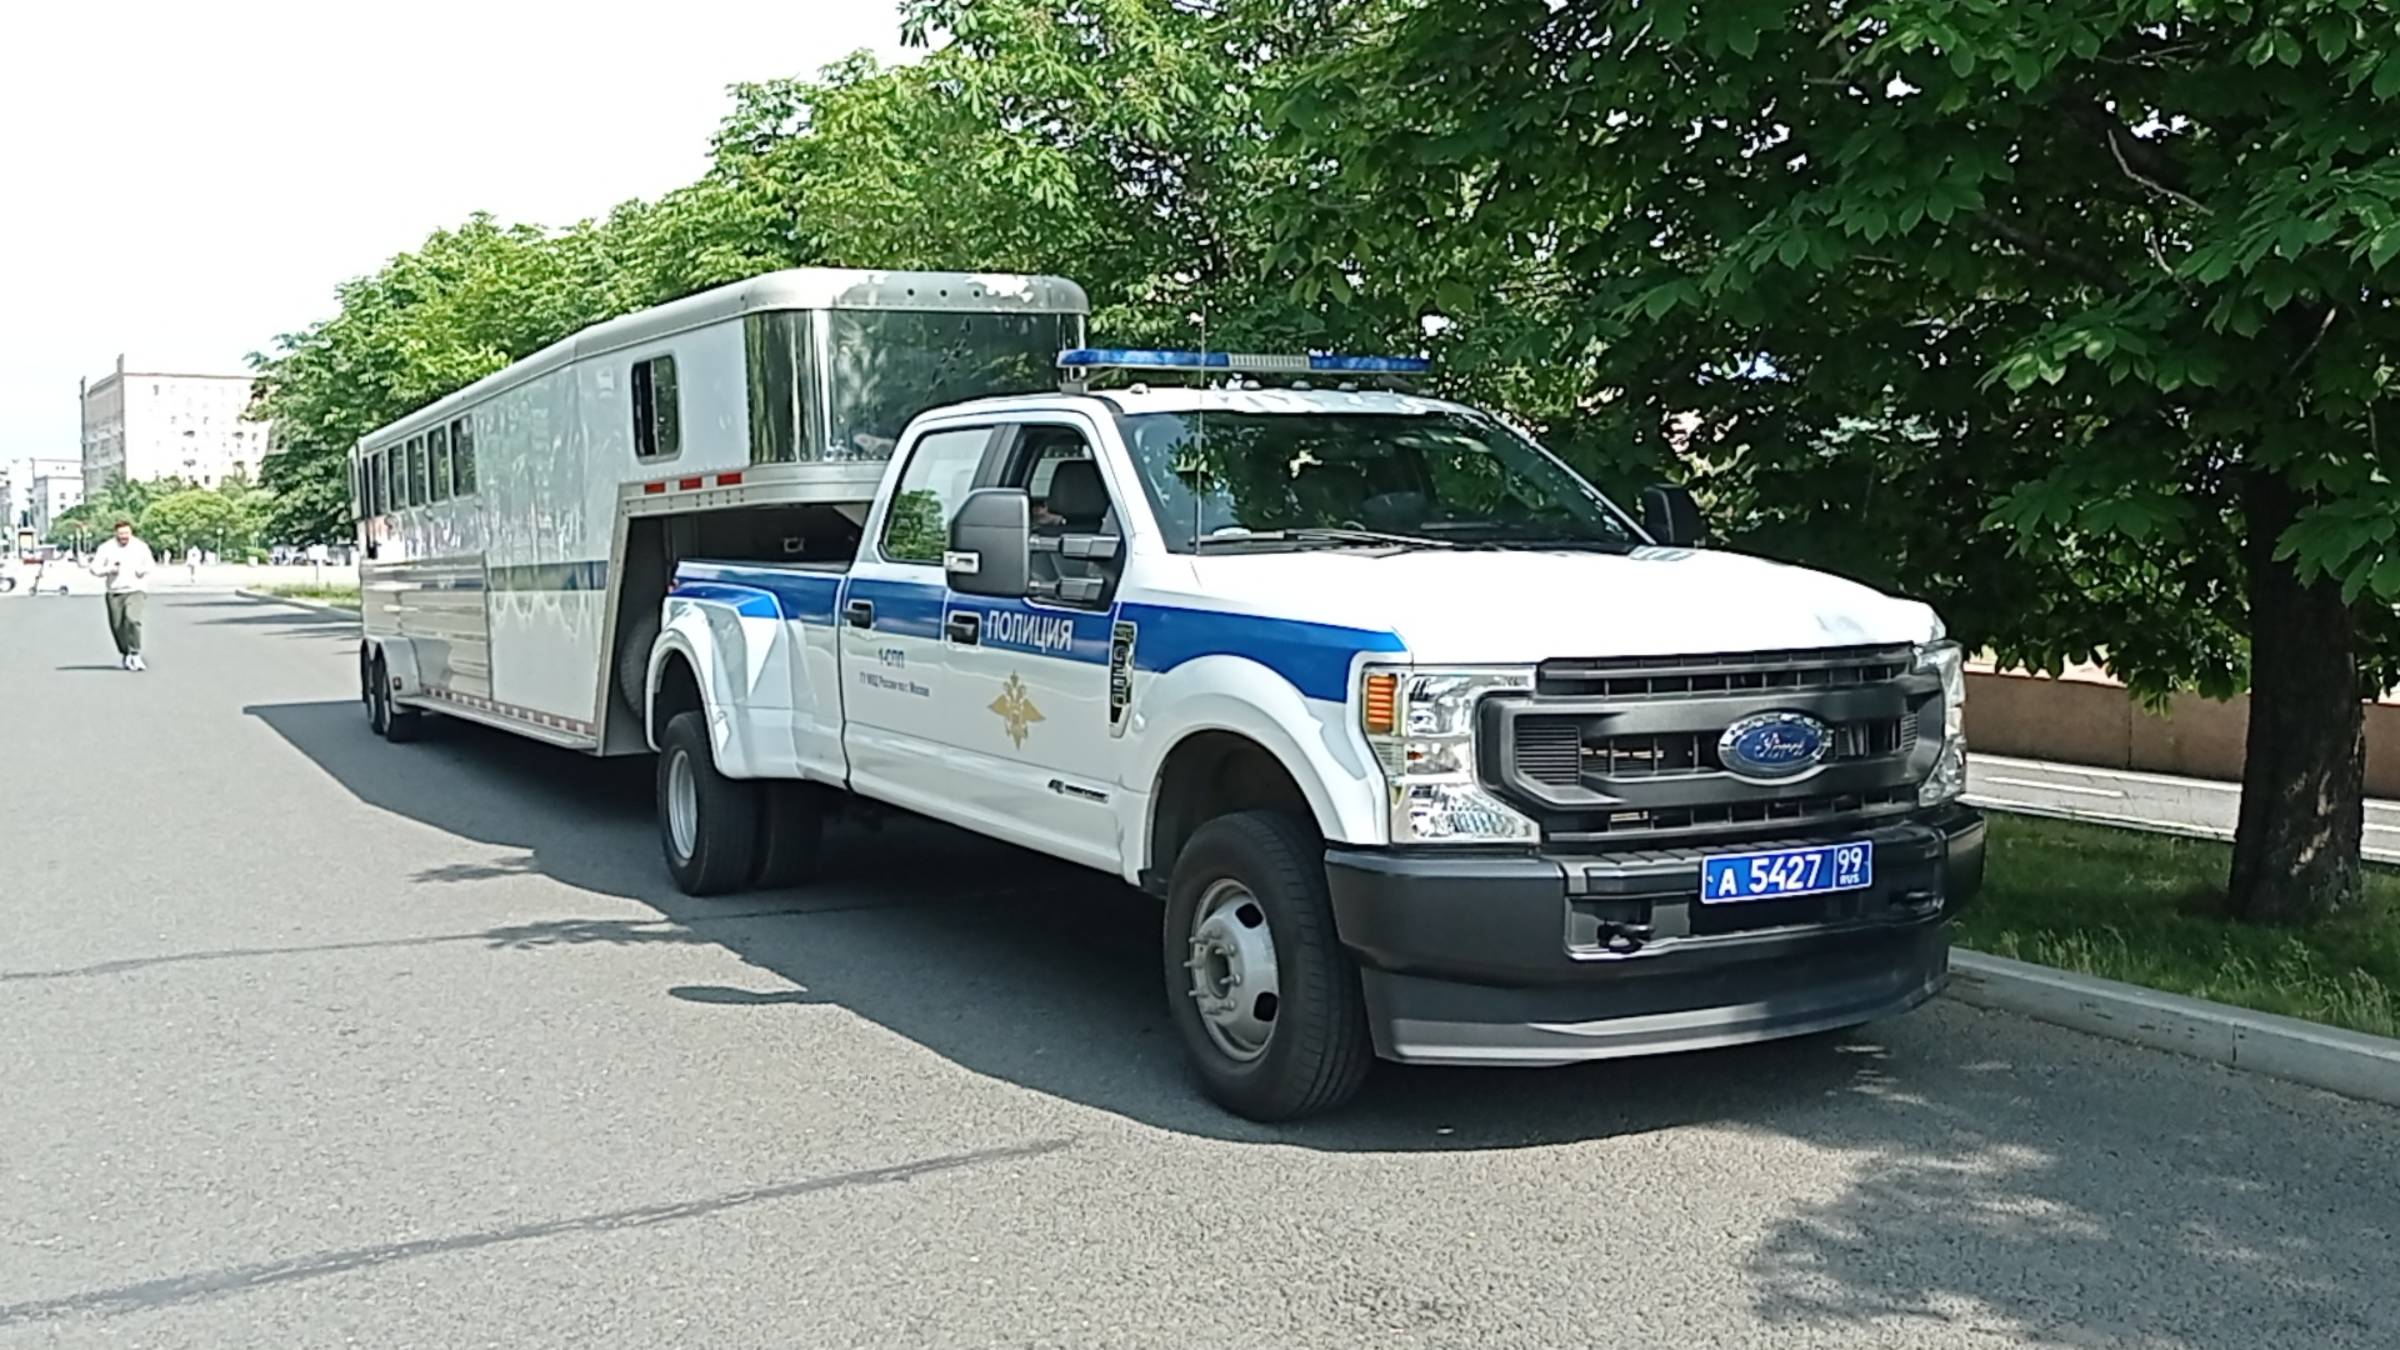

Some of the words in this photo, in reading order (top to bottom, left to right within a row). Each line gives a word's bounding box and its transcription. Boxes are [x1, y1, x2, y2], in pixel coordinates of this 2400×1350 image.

[986, 609, 1073, 653] ПОЛИЦИЯ
[1750, 854, 1822, 893] 5427
[1837, 847, 1863, 874] 99
[1839, 874, 1860, 885] RUS
